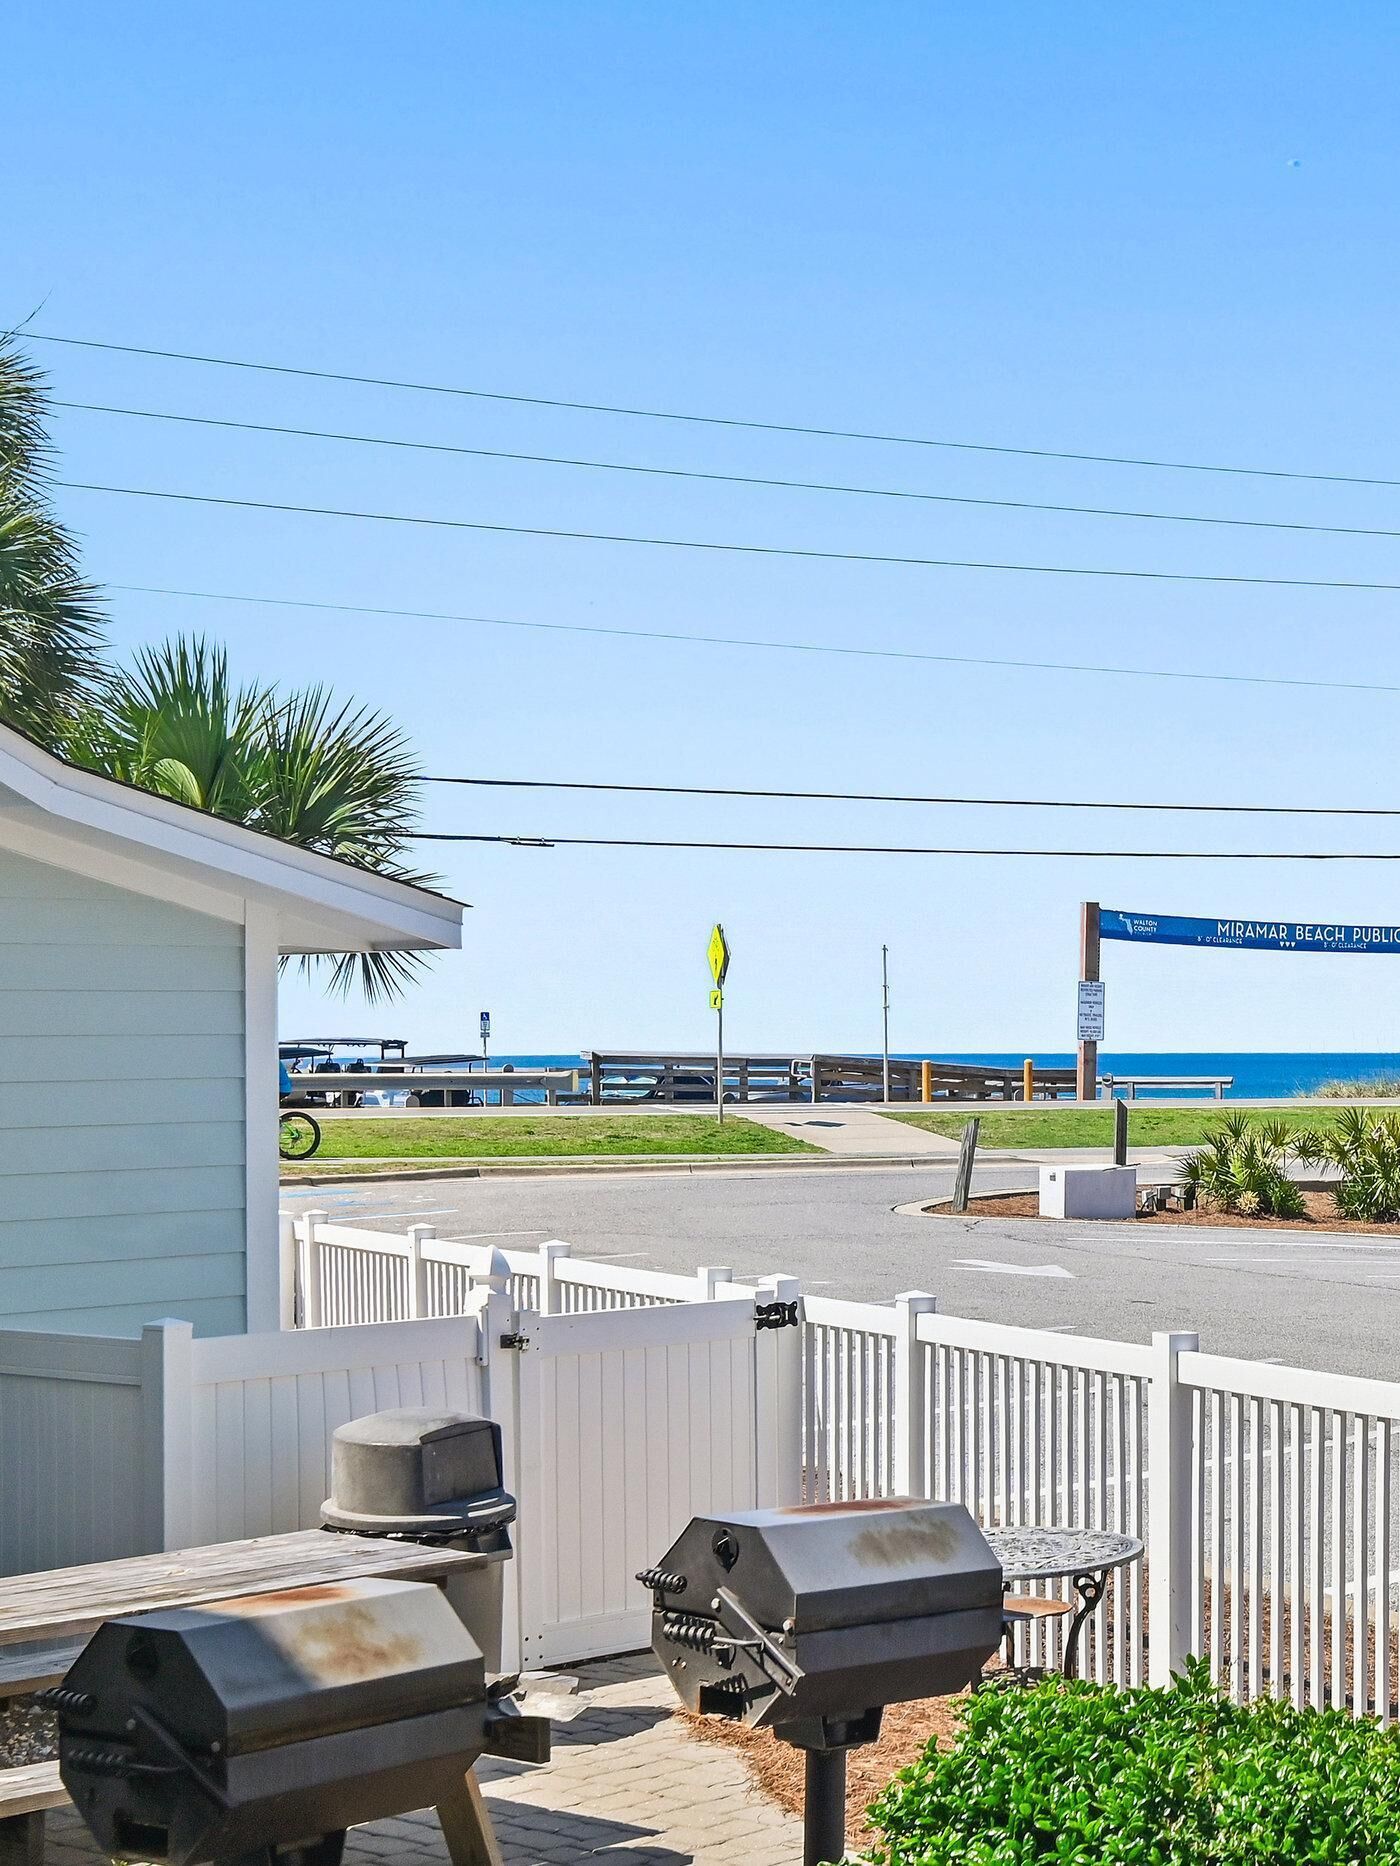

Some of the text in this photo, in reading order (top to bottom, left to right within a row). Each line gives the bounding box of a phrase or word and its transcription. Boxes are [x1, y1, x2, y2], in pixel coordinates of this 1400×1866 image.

[1133, 919, 1158, 927] WALTON
[1133, 925, 1157, 933] COUNTY
[1217, 921, 1288, 940] MIRAMAR
[1295, 925, 1345, 942] BEACH
